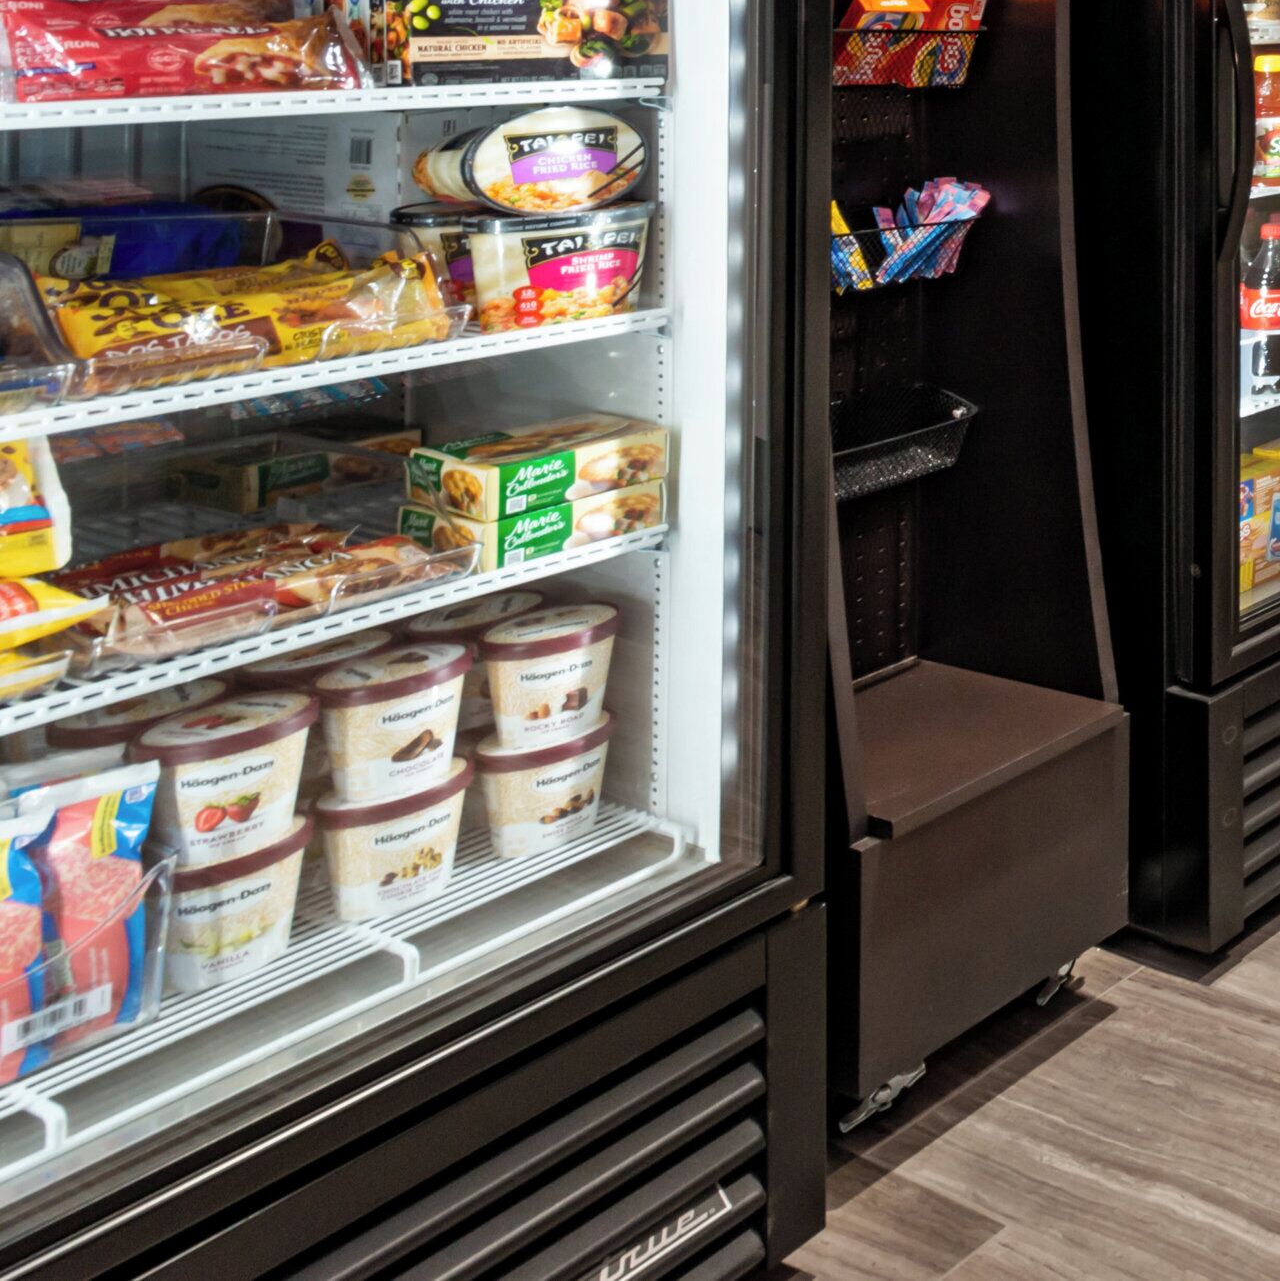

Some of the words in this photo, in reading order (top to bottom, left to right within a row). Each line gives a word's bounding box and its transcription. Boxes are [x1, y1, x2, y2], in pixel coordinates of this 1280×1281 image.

[533, 165, 568, 175] FRIED
[571, 160, 598, 171] RICE
[538, 153, 592, 166] CHICKEN
[541, 236, 584, 256] TAI
[560, 264, 595, 275] FRIED
[598, 259, 621, 270] RICE
[571, 252, 615, 265] SHRIMP
[506, 459, 565, 486] Marie
[504, 511, 562, 539] Marie
[388, 751, 445, 778] CHOCOLATE
[190, 820, 265, 847] STRAWBERRY
[201, 951, 250, 971] VANILLA
